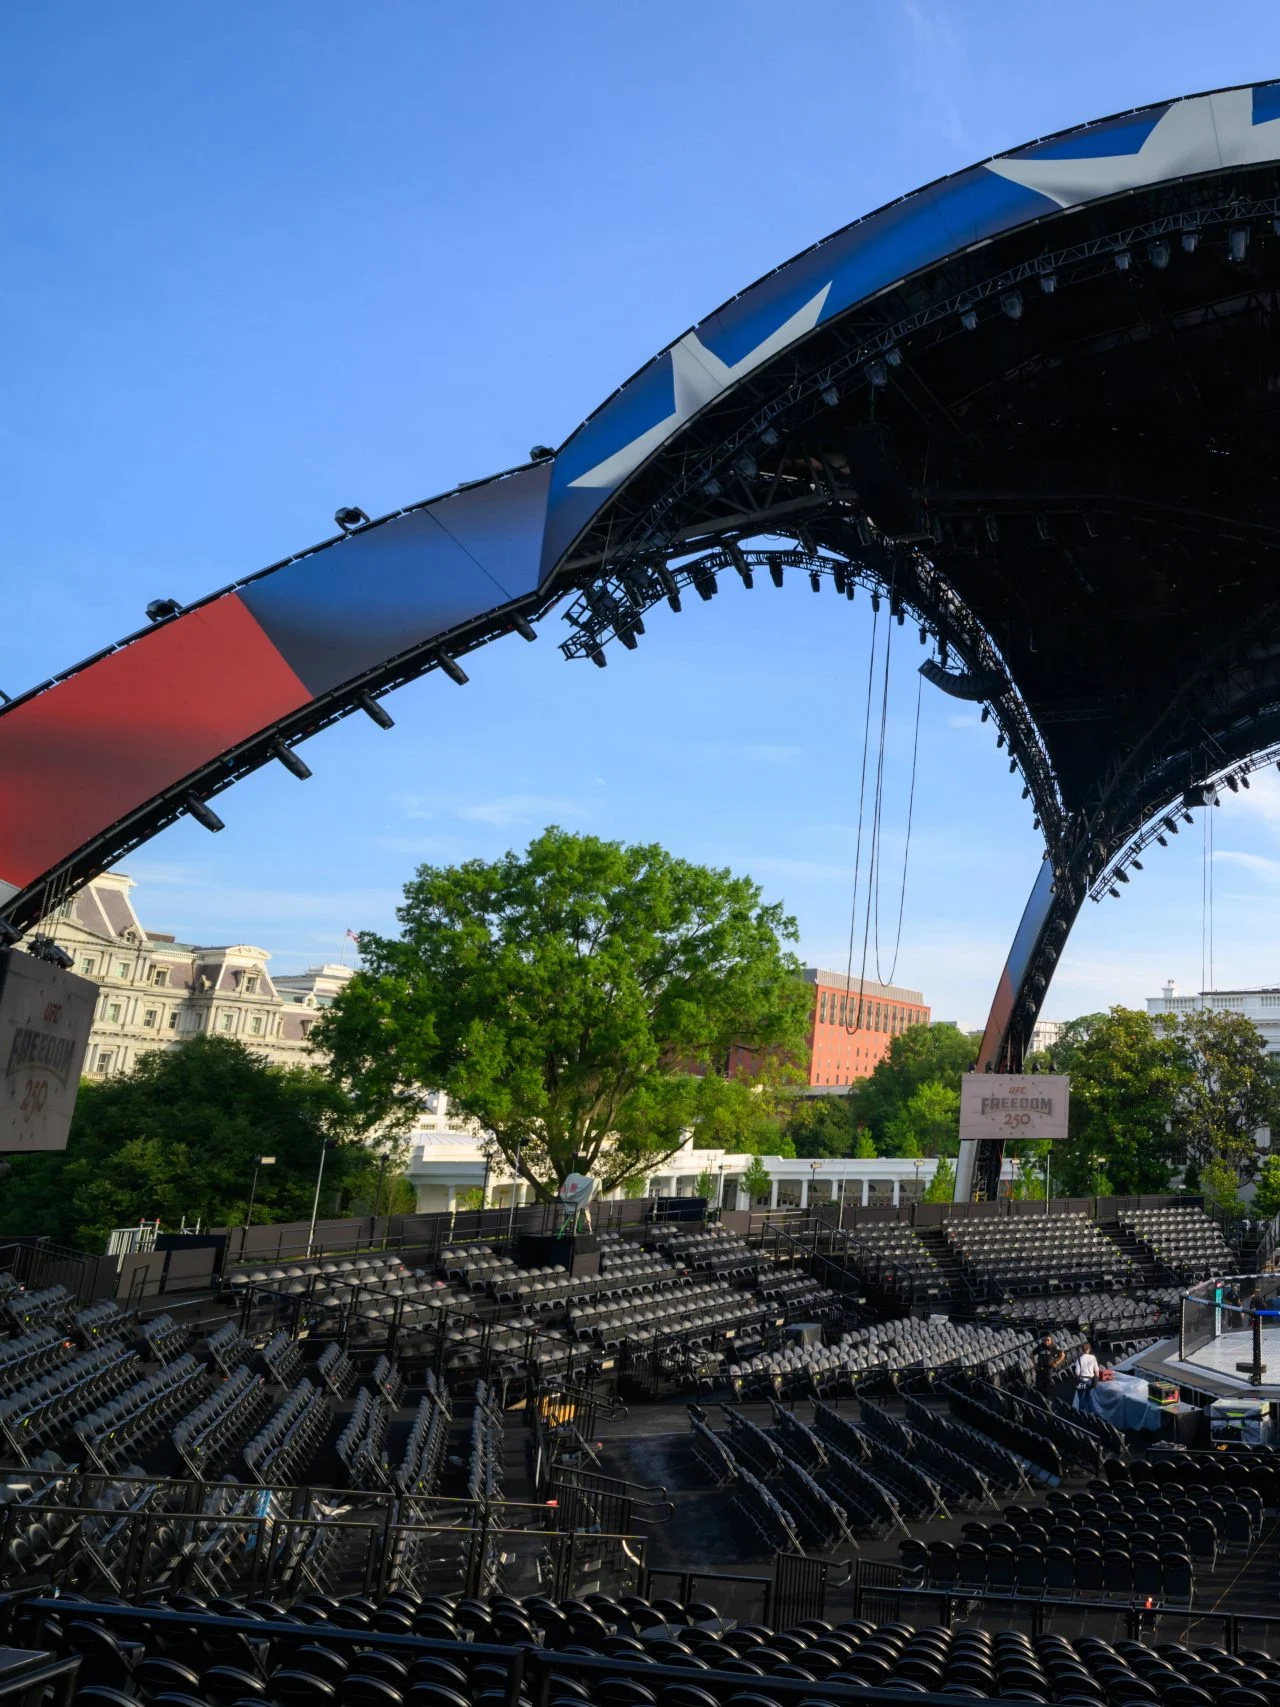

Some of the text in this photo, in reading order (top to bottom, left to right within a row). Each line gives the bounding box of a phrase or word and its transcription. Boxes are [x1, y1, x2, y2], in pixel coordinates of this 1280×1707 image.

[1008, 1086, 1027, 1095] UFC
[20, 1079, 49, 1123] 250
[981, 1097, 1053, 1115] FREEDOM
[1003, 1113, 1031, 1129] 250
